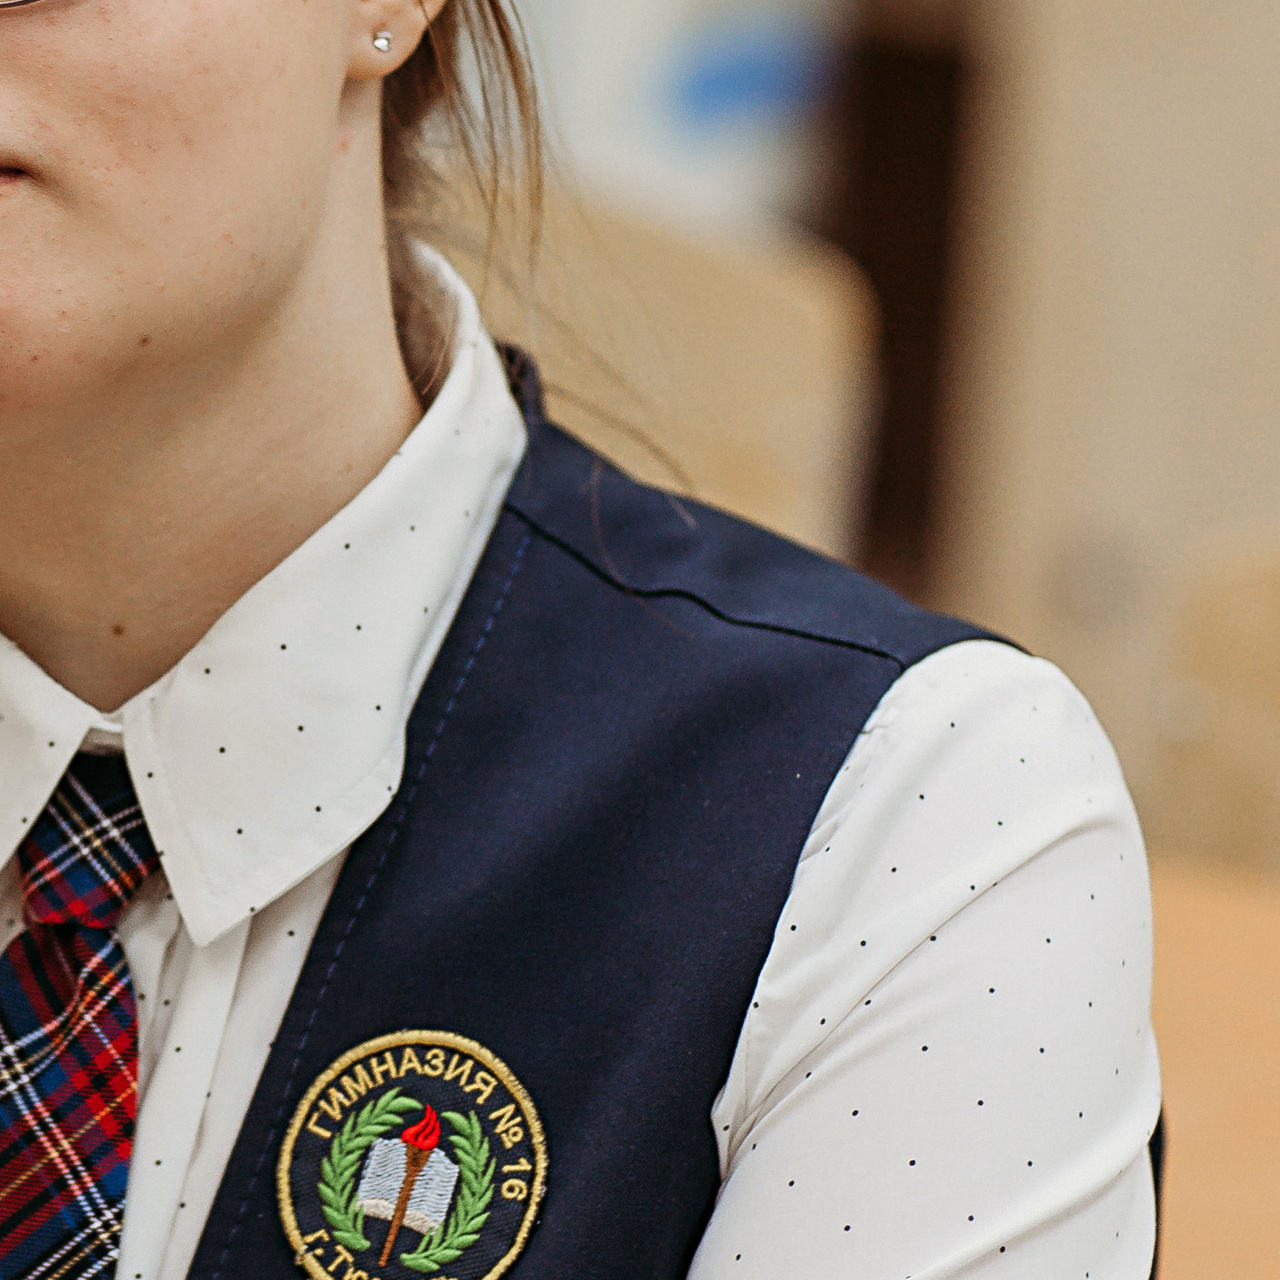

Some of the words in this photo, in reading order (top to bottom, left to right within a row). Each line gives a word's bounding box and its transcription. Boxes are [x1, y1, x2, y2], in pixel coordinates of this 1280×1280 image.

[307, 1047, 497, 1139] ГИМНАЗИЯ
[489, 1103, 524, 1149] №
[501, 1157, 532, 1201] 16
